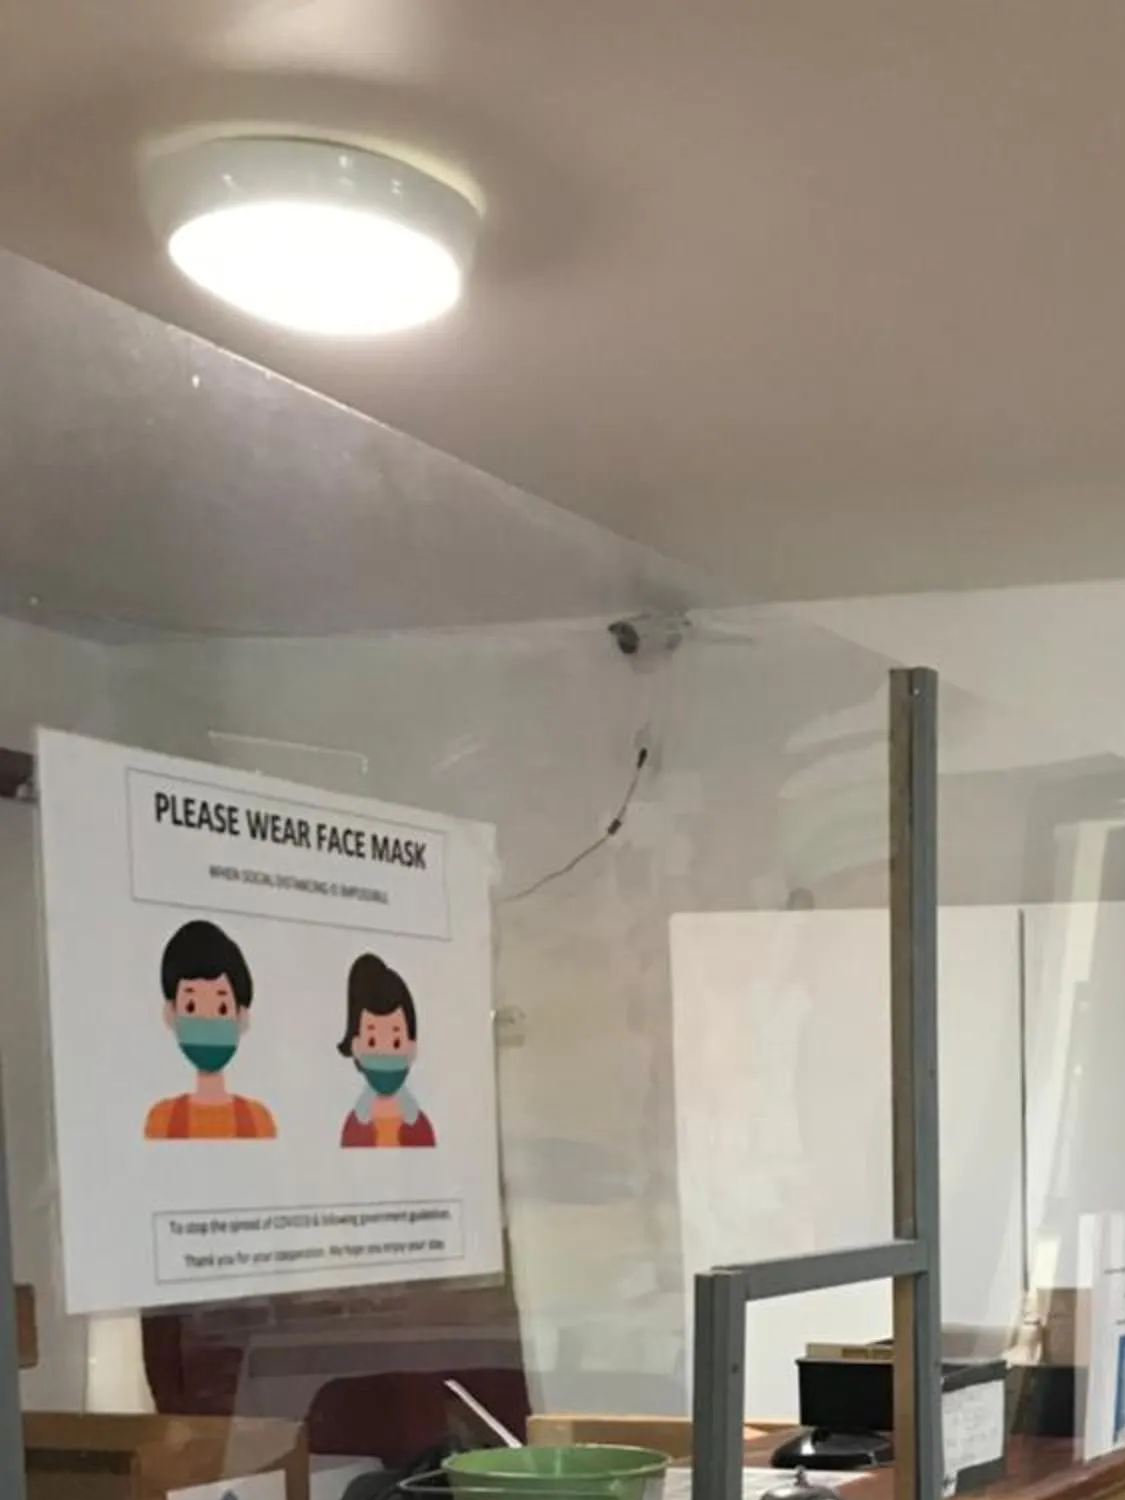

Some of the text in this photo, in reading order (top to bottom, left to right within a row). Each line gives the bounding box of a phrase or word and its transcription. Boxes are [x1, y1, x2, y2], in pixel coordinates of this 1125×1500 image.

[154, 791, 427, 870] PLEASE WEAR FACE MASK
